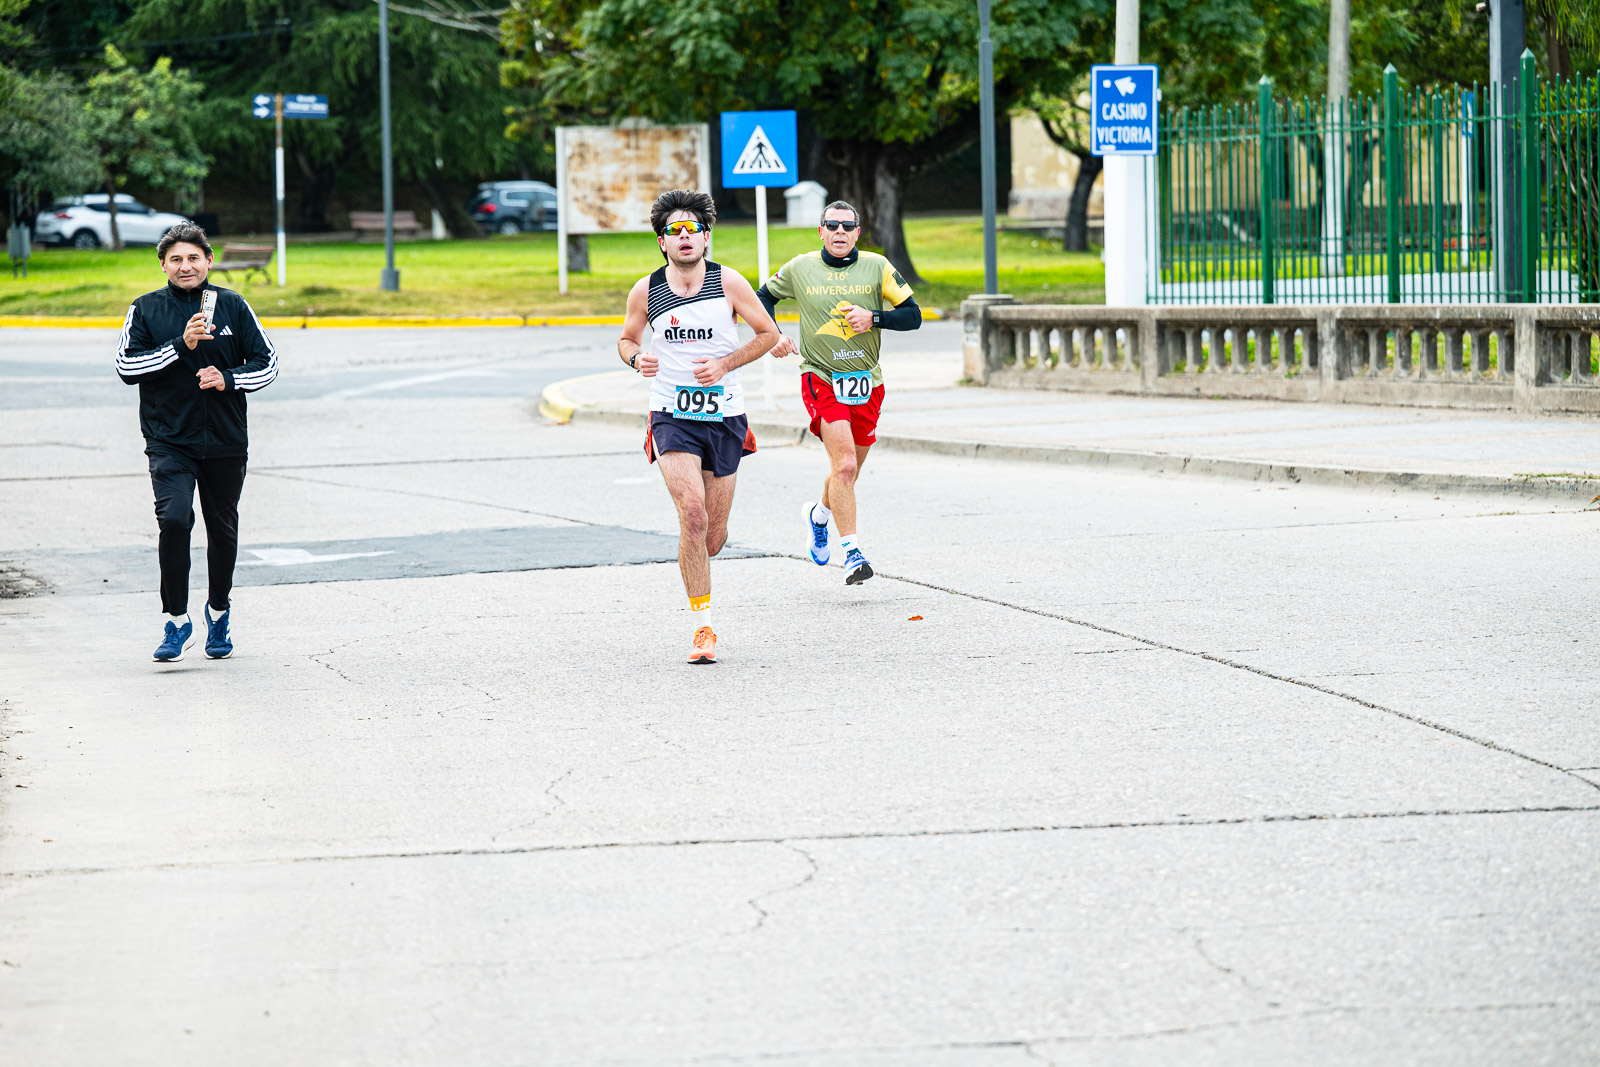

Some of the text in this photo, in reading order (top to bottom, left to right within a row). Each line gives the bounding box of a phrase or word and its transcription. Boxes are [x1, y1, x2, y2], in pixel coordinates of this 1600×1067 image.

[1102, 102, 1147, 120] CASINO
[1096, 126, 1152, 144] VICTORIA
[806, 284, 873, 296] ANIVERSARIO
[835, 375, 870, 398] 120
[677, 388, 719, 415] 095
